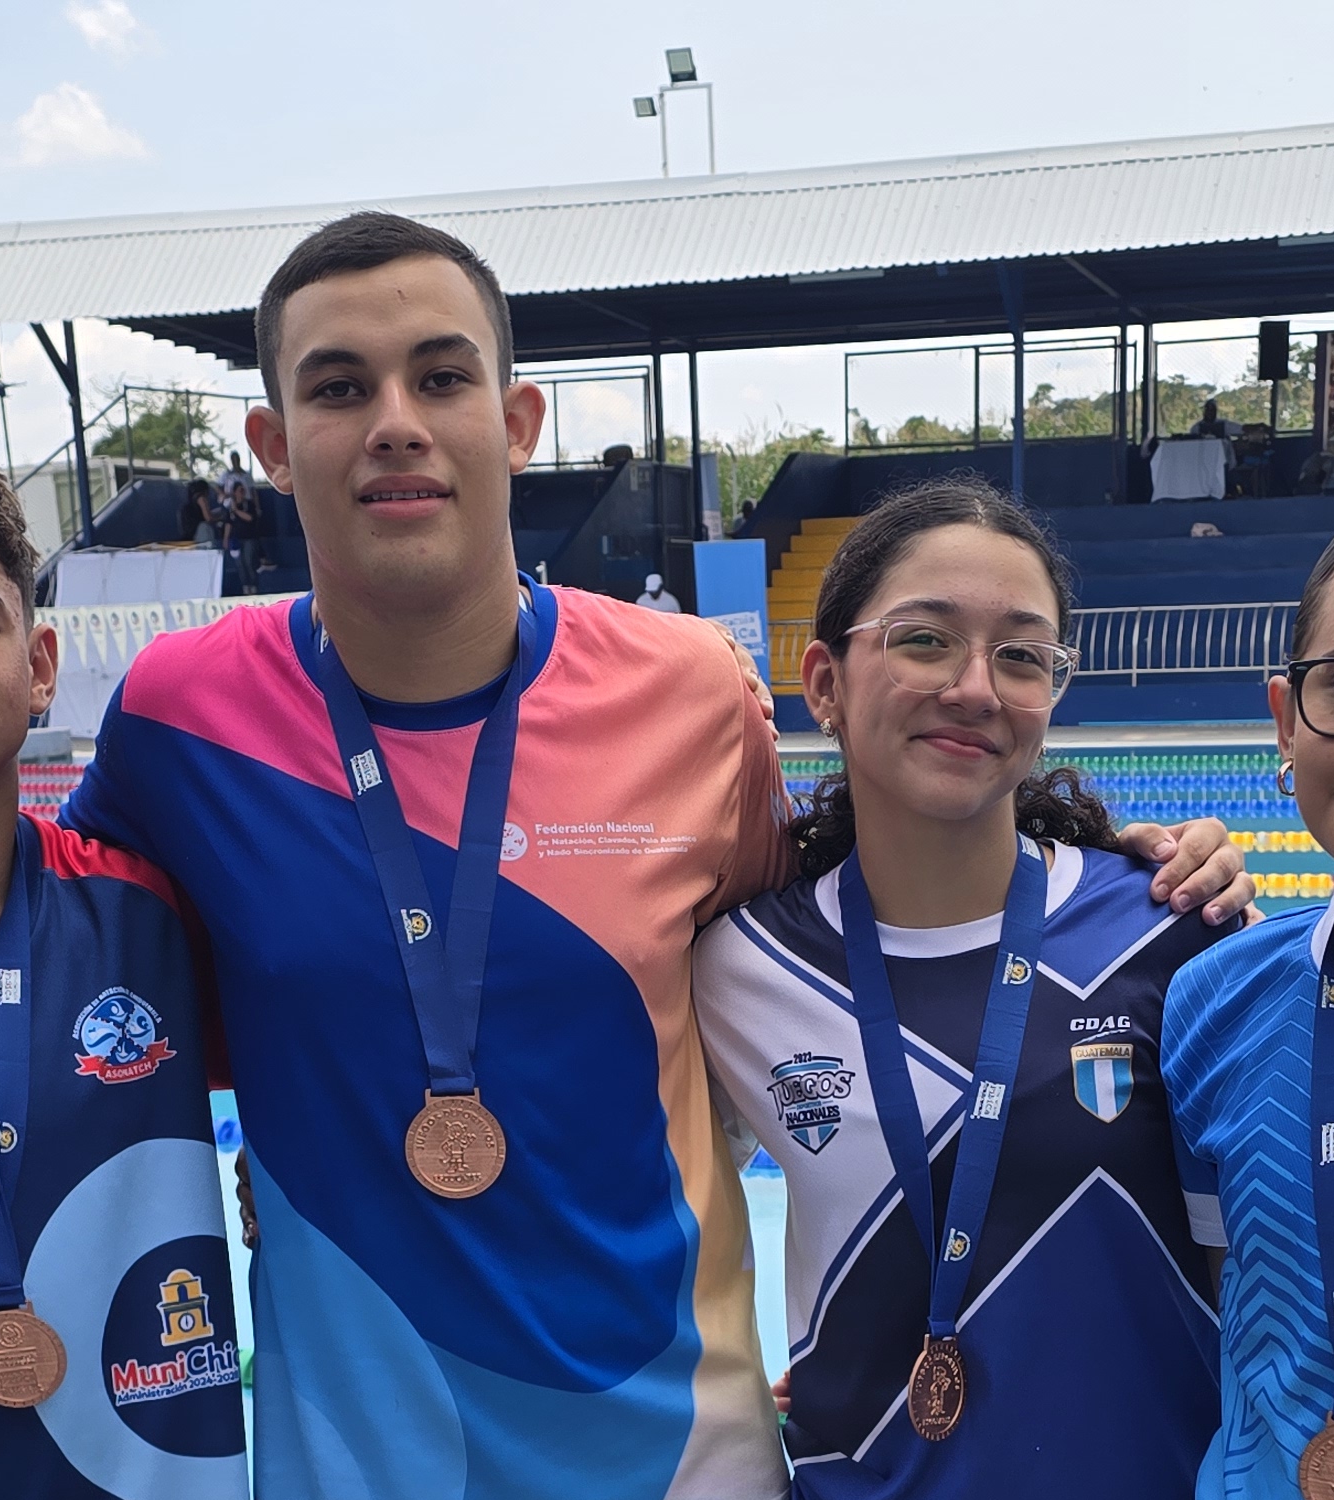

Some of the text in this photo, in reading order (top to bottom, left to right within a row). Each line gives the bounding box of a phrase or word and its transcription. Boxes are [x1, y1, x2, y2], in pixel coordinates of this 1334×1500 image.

[535, 822, 655, 835] Federación Nacional
[1070, 1016, 1131, 1032] CDAG
[1076, 1047, 1131, 1058] GUATEMALA
[105, 1061, 153, 1079] ASONATCH
[767, 1070, 856, 1121] JUEGOS
[785, 1105, 841, 1125] NACIONALES
[117, 1384, 188, 1403] Administración
